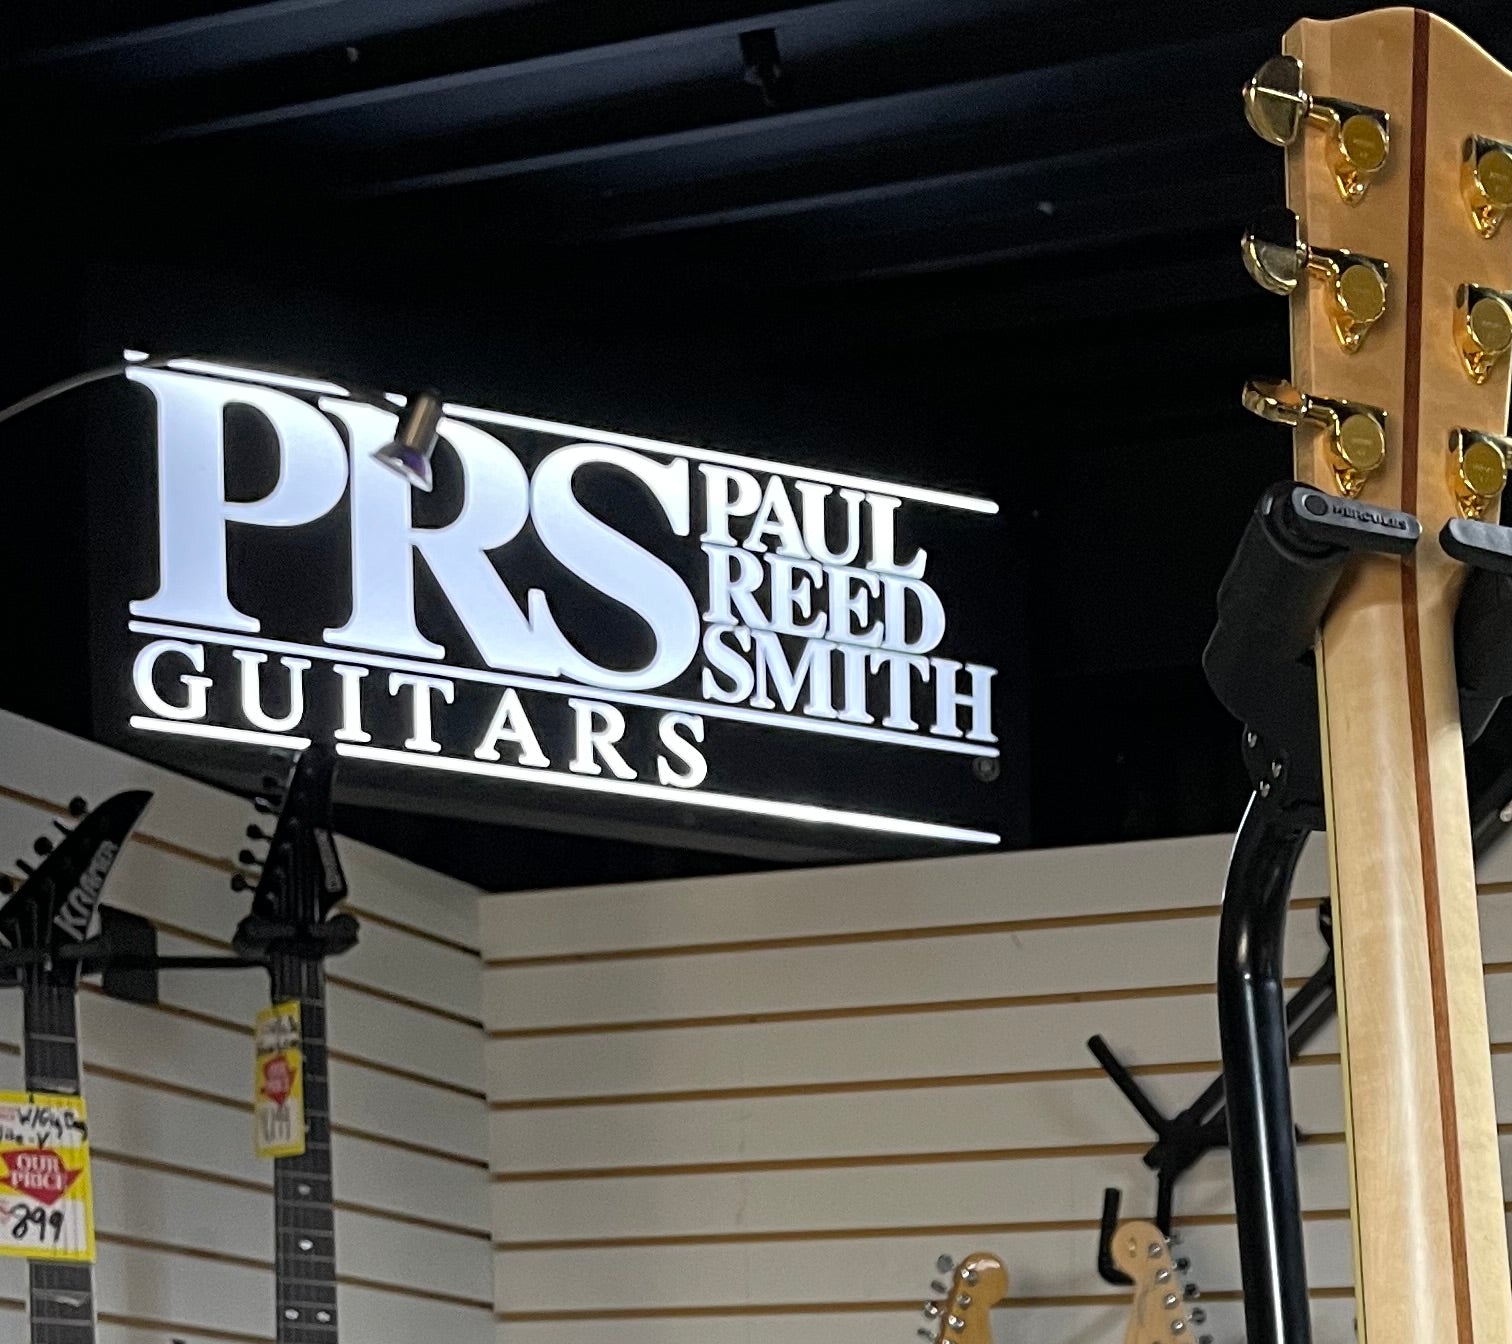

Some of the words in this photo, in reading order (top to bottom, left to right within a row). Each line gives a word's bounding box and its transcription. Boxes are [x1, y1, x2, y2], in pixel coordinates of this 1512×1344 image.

[126, 366, 701, 691] PRS
[699, 462, 927, 579] PAUL
[703, 543, 946, 656] REED
[130, 640, 707, 788] GUITARS
[702, 624, 998, 743] SMITH
[17, 1152, 60, 1173] OUR
